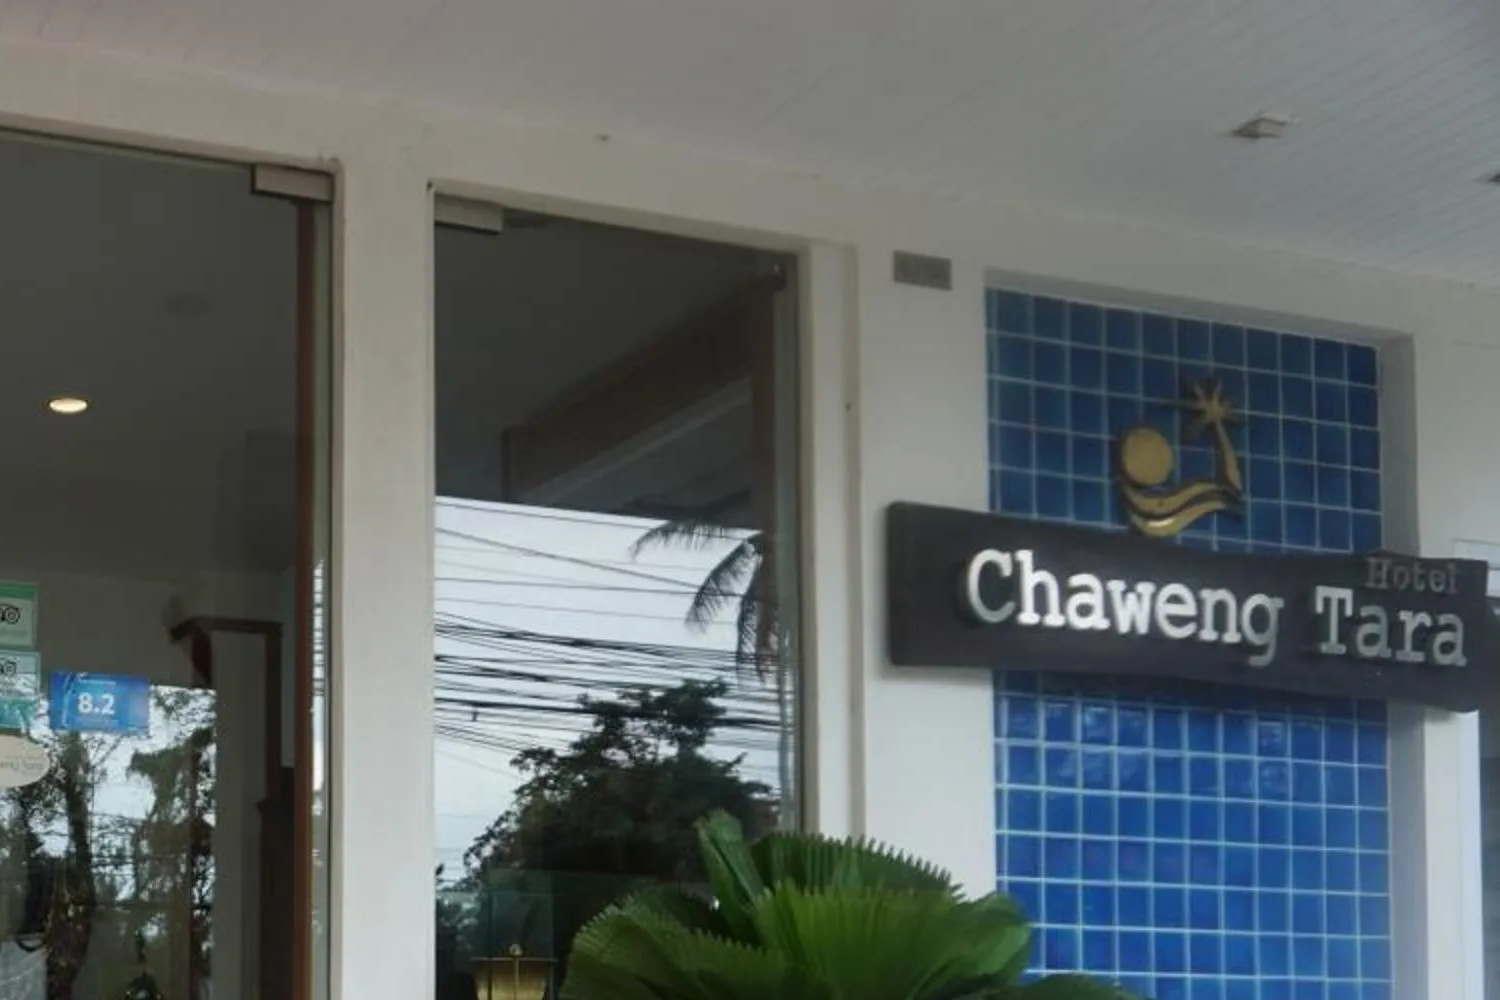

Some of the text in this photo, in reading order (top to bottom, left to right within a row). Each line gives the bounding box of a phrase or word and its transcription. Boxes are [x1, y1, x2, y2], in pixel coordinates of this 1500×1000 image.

[1365, 557, 1459, 595] Hotel
[966, 549, 1467, 667] Chaweng Tara
[78, 692, 115, 715] 8.2
